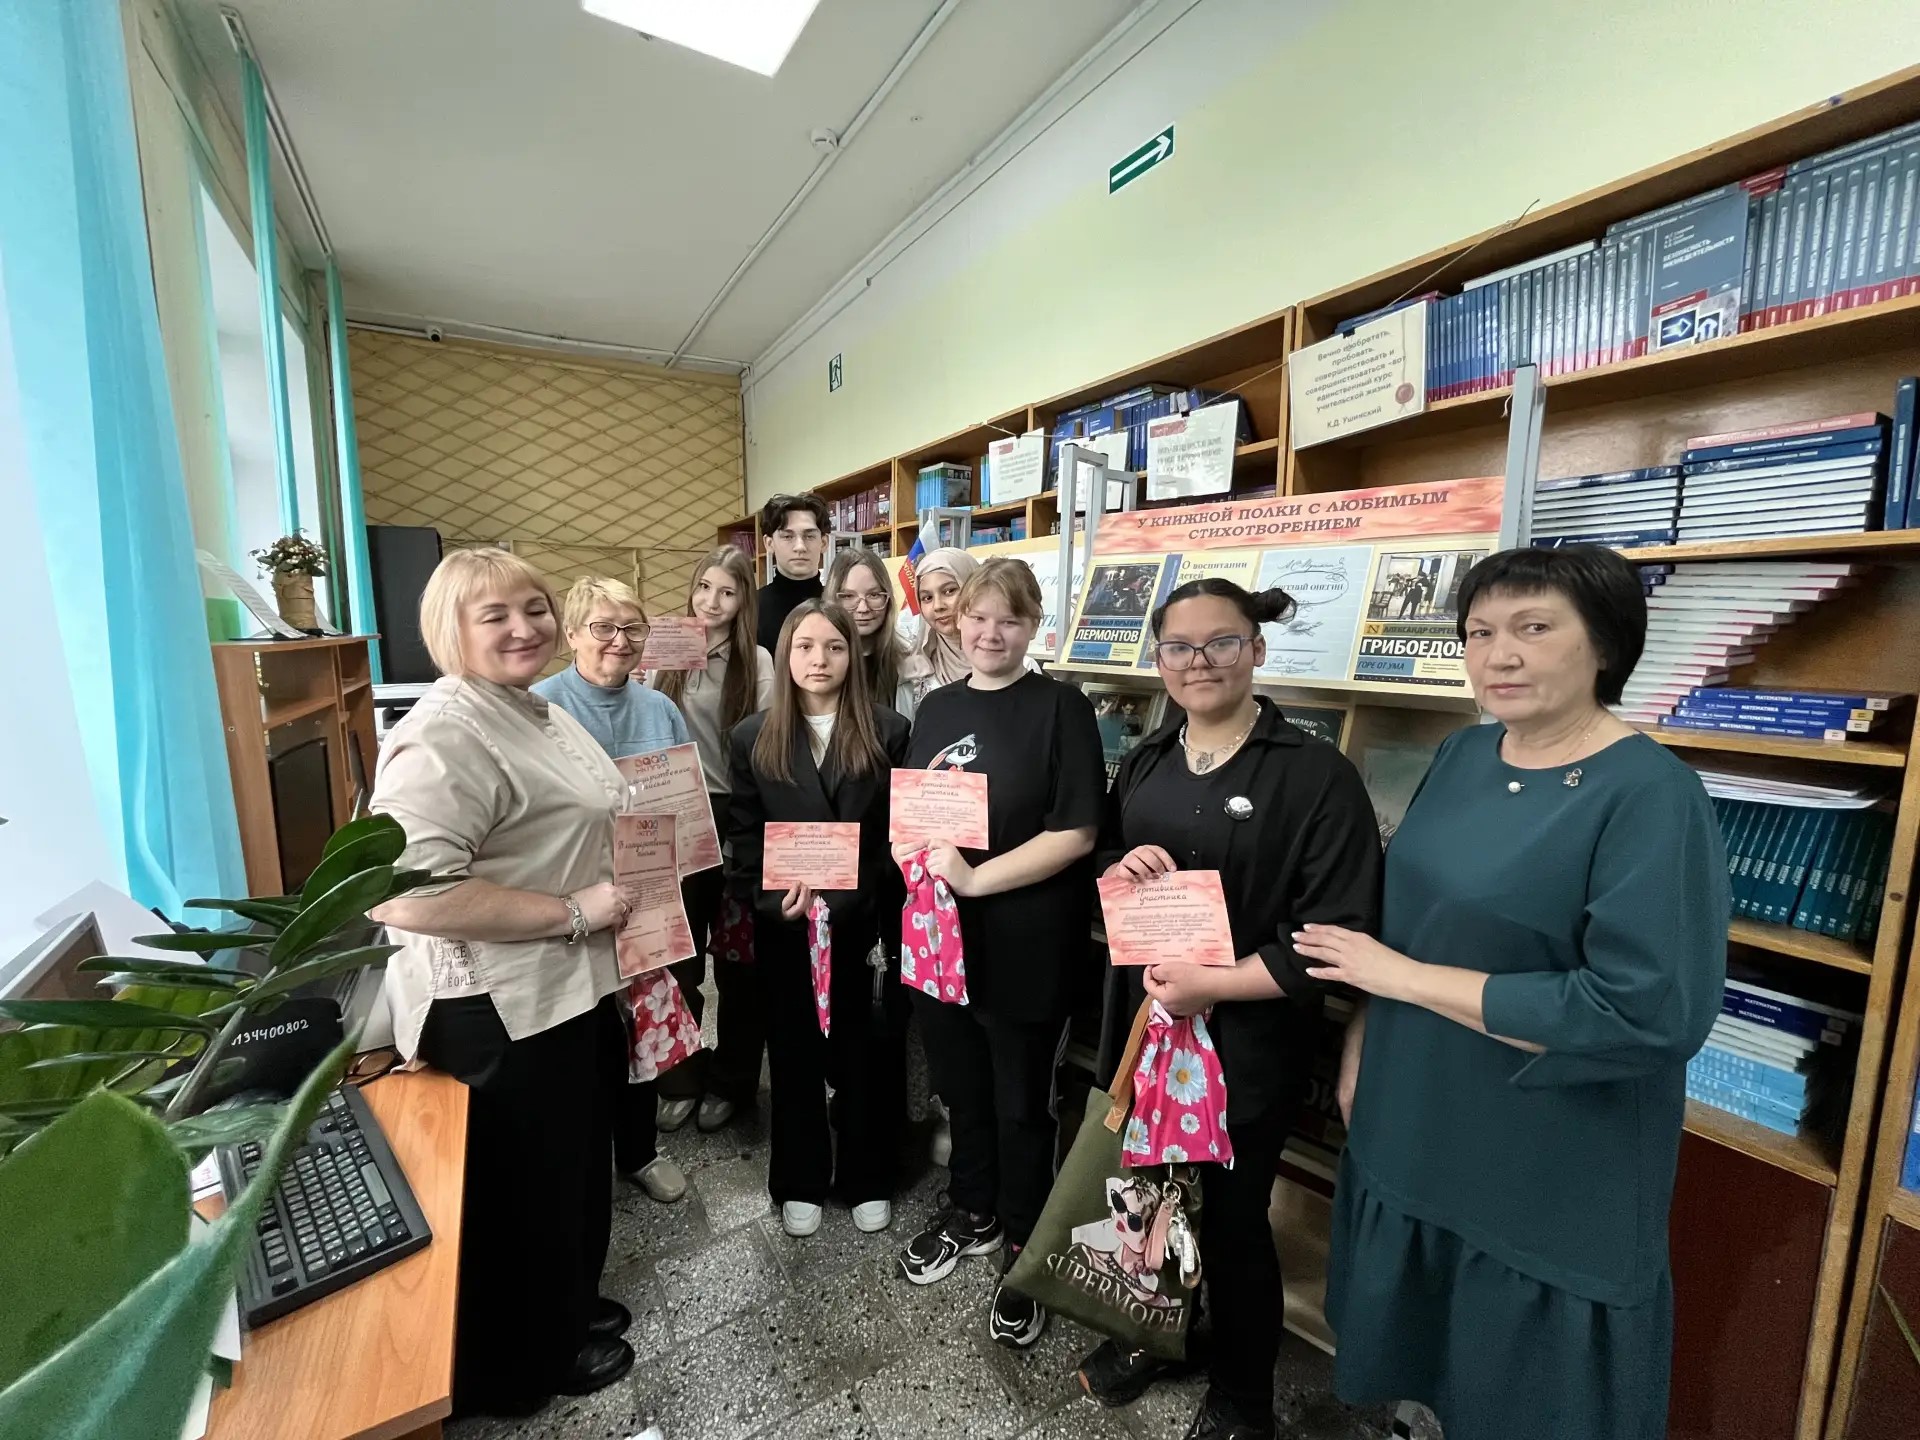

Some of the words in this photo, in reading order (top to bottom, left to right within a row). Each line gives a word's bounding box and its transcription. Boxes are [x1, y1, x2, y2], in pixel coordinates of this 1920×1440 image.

[1317, 347, 1341, 361] Вечно
[1314, 351, 1387, 382] совершенствовать
[1305, 363, 1386, 395] совершенствоваться
[1316, 378, 1372, 402] единственный
[1374, 371, 1393, 383] курс
[1316, 391, 1364, 413] учительской
[1342, 405, 1382, 424] Ушинский
[1138, 518, 1148, 528] У
[1150, 507, 1233, 528] КНИЖНОЙ
[1238, 504, 1303, 521] ПОЛКИ
[1308, 503, 1321, 514] С
[1326, 491, 1449, 512] ЛЮБИМЫМ
[1188, 517, 1362, 540] СТИХОТВОРЕНИЕМ
[1182, 561, 1191, 569] О
[1075, 629, 1139, 642] ЛЕРМОНТОВ
[1383, 625, 1428, 634] АЛЕКСАНДР
[1361, 638, 1465, 658] ГРИБОЕДОВ
[1358, 661, 1375, 669] ГОРЕ
[1377, 661, 1386, 669] ОТ
[1388, 662, 1405, 670] УМА
